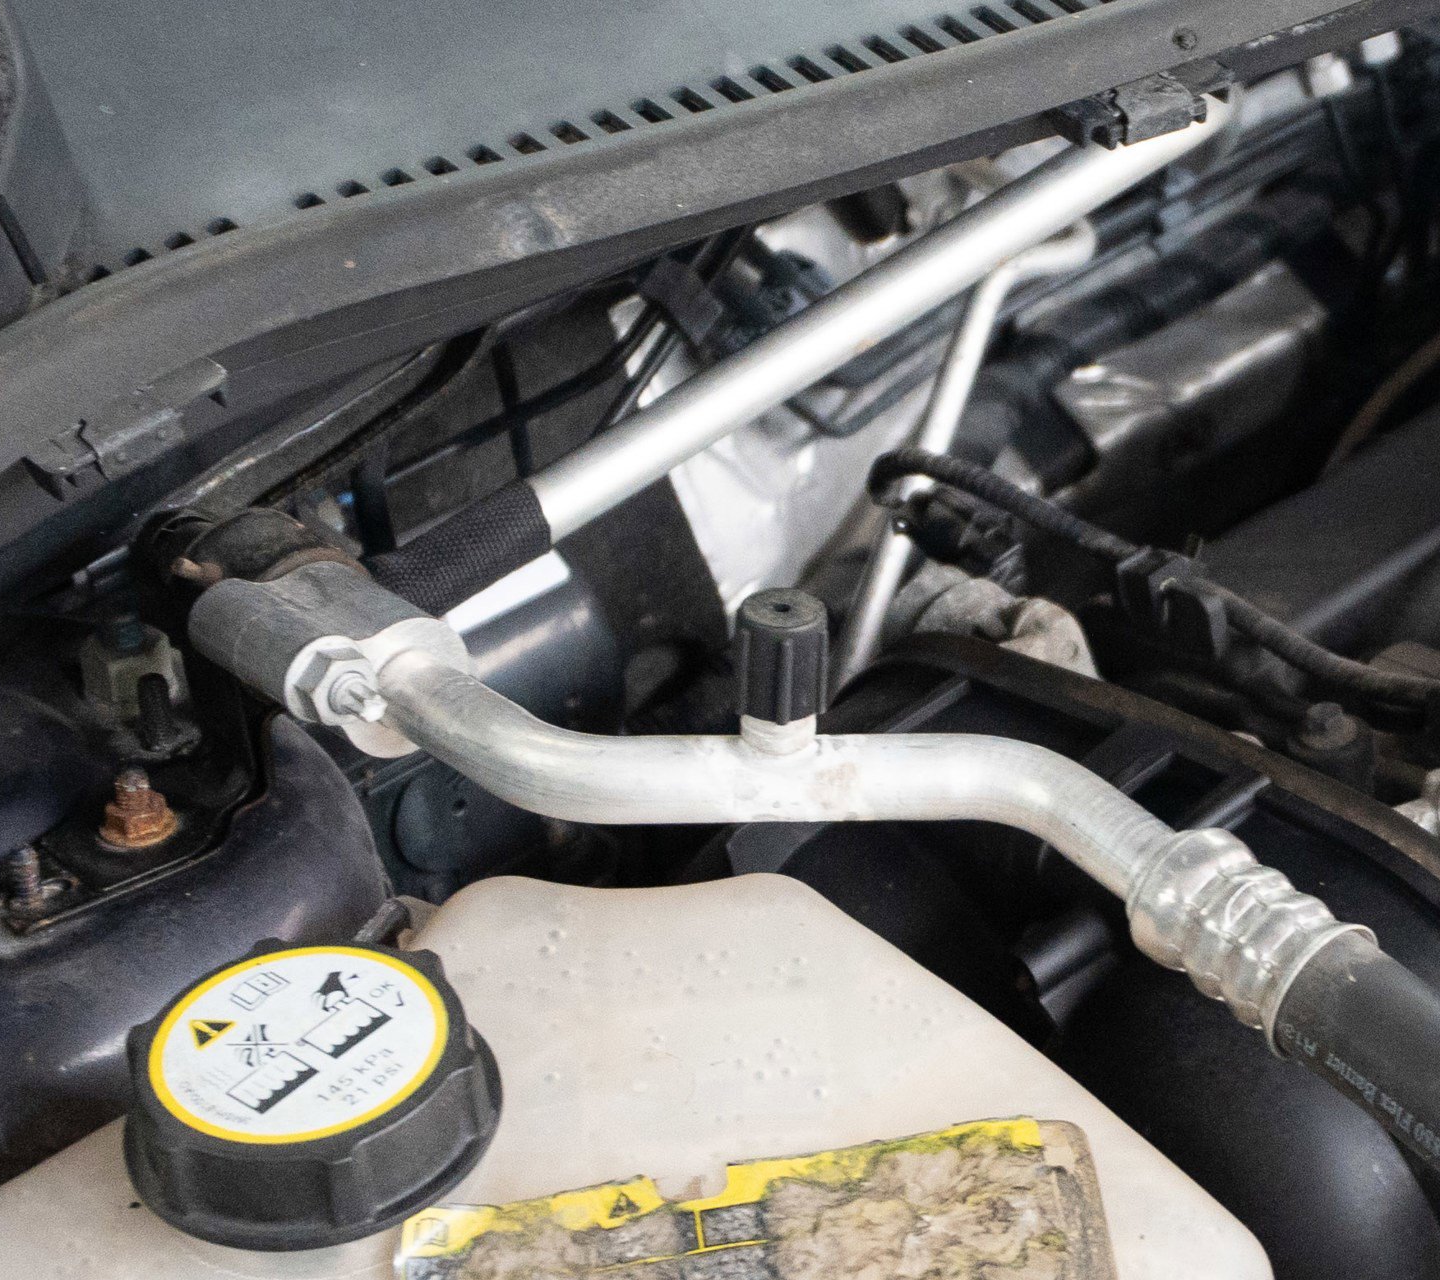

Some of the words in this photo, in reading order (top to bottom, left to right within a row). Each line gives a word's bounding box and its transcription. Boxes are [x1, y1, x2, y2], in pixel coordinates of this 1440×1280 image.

[369, 980, 395, 999] OK
[317, 1076, 354, 1102] 145
[356, 1048, 395, 1076] kPa
[342, 1085, 370, 1106] 21
[374, 1061, 405, 1088] psi
